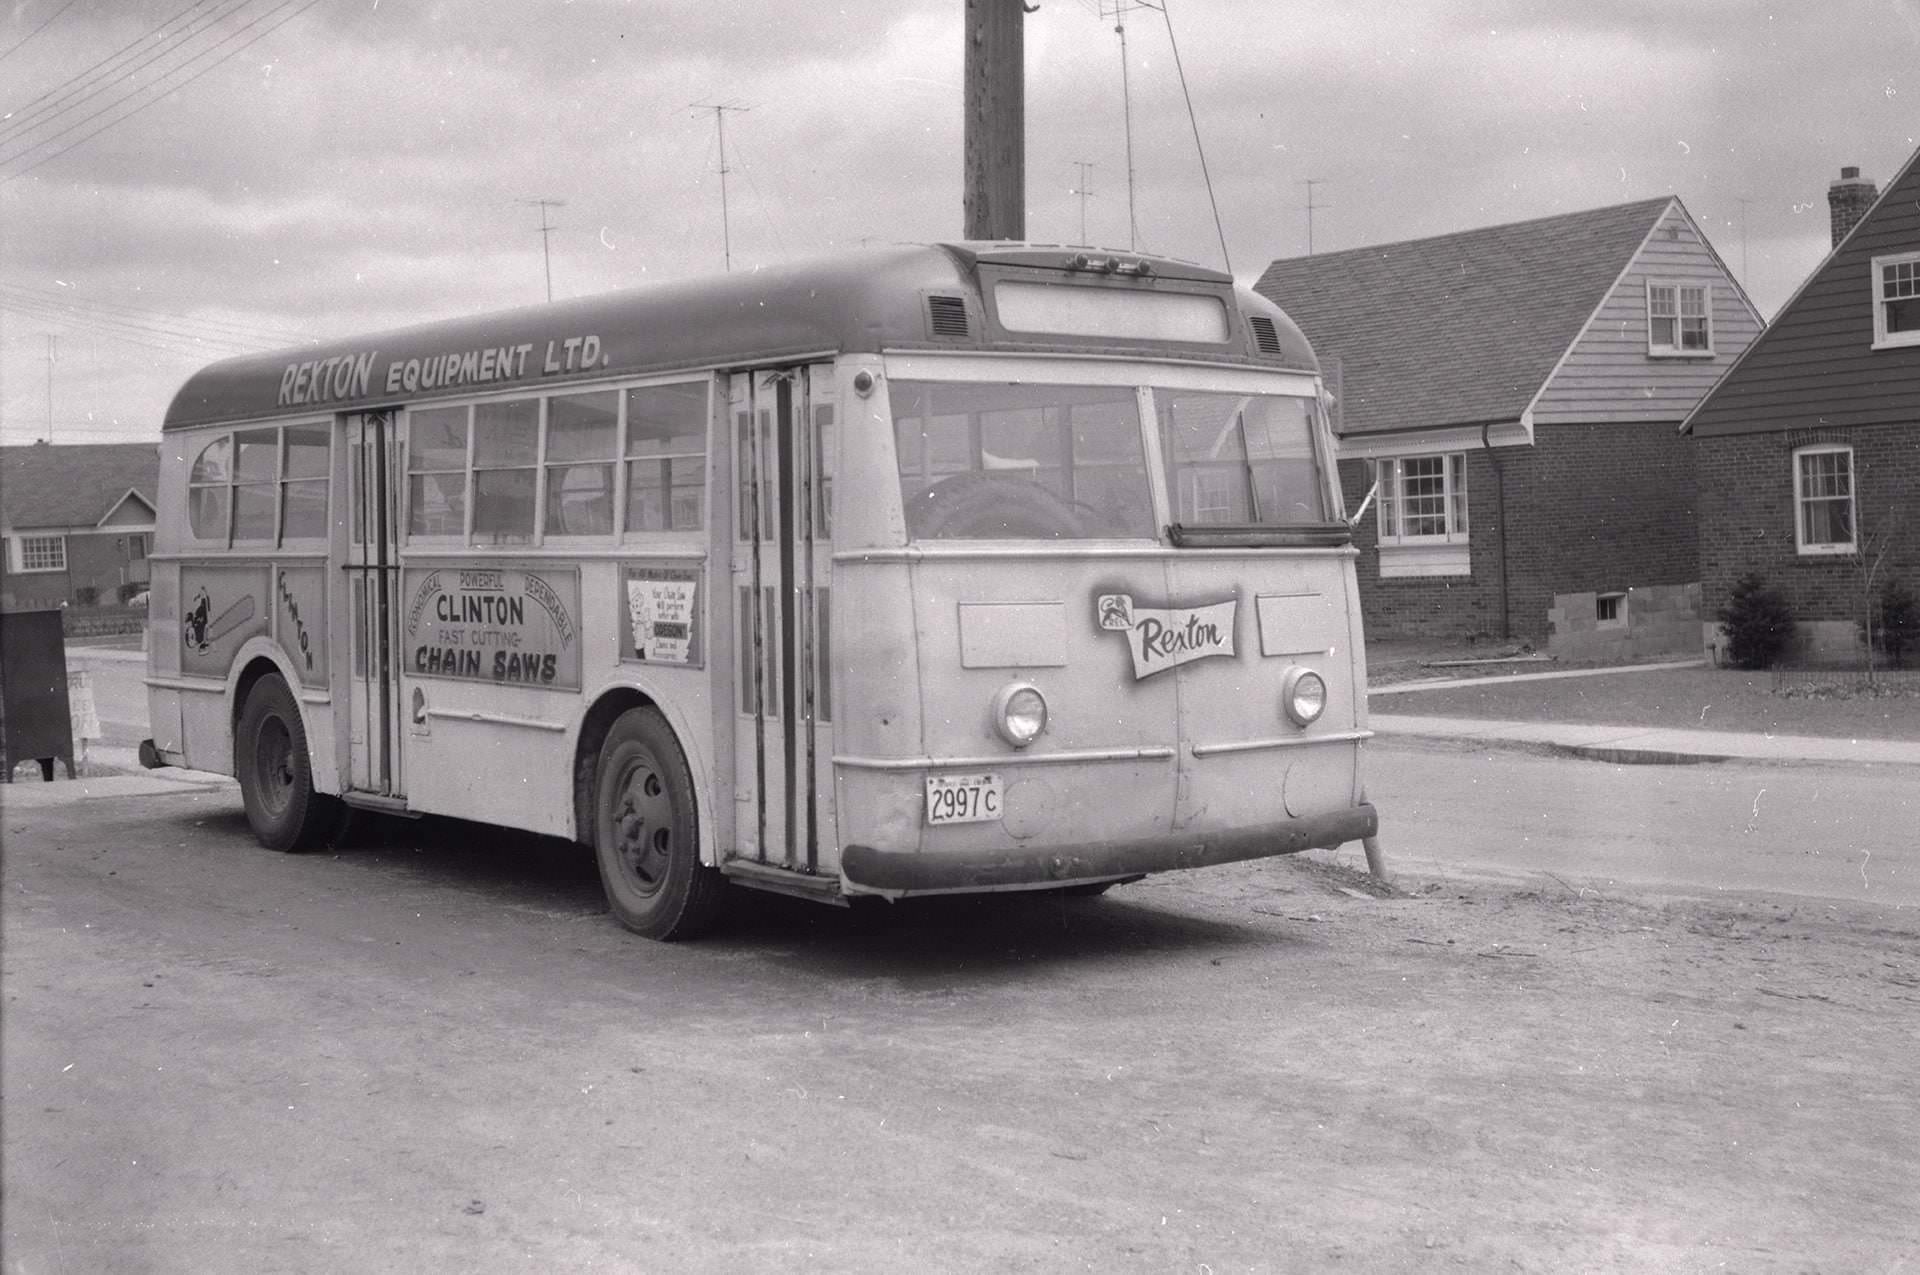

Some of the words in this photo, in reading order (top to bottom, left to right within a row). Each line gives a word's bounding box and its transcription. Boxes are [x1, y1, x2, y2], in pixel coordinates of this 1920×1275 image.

[278, 351, 378, 406] REXTON
[384, 343, 533, 393] EQUIPMENT
[543, 335, 609, 373] LTD.
[459, 572, 505, 588] POWERFUL
[279, 571, 313, 671] CLINTON
[436, 594, 524, 625] CLINTON
[524, 576, 573, 643] DEPENDABLE
[438, 629, 465, 646] FAST
[471, 630, 523, 648] CUTTING
[1136, 614, 1223, 662] Rexton
[415, 645, 481, 675] CHAIN
[493, 650, 557, 682] SAWS
[932, 788, 980, 821] 2997
